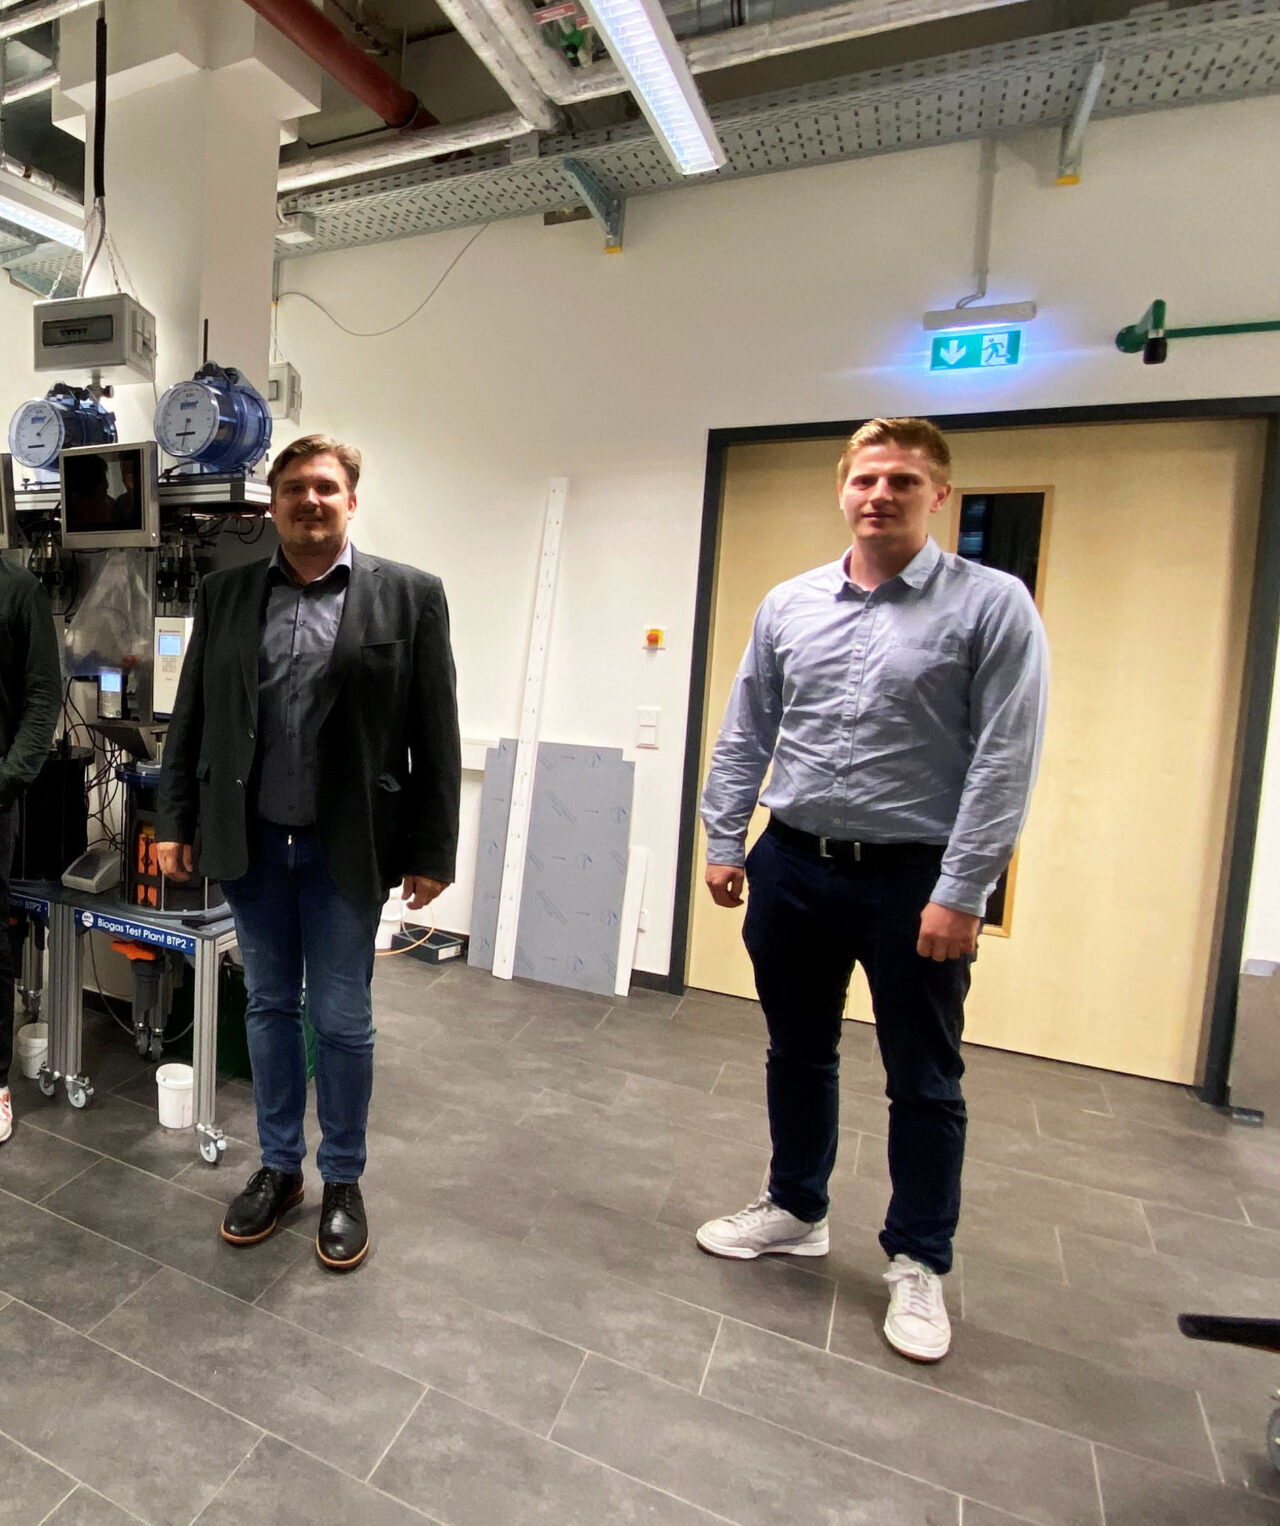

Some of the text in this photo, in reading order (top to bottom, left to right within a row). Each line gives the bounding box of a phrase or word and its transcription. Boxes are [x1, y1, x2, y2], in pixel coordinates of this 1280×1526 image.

[24, 900, 41, 912] BTP2
[97, 917, 124, 932] Biogas
[125, 924, 142, 936] Test
[143, 930, 165, 943] Plant
[166, 936, 186, 949] BTP2
